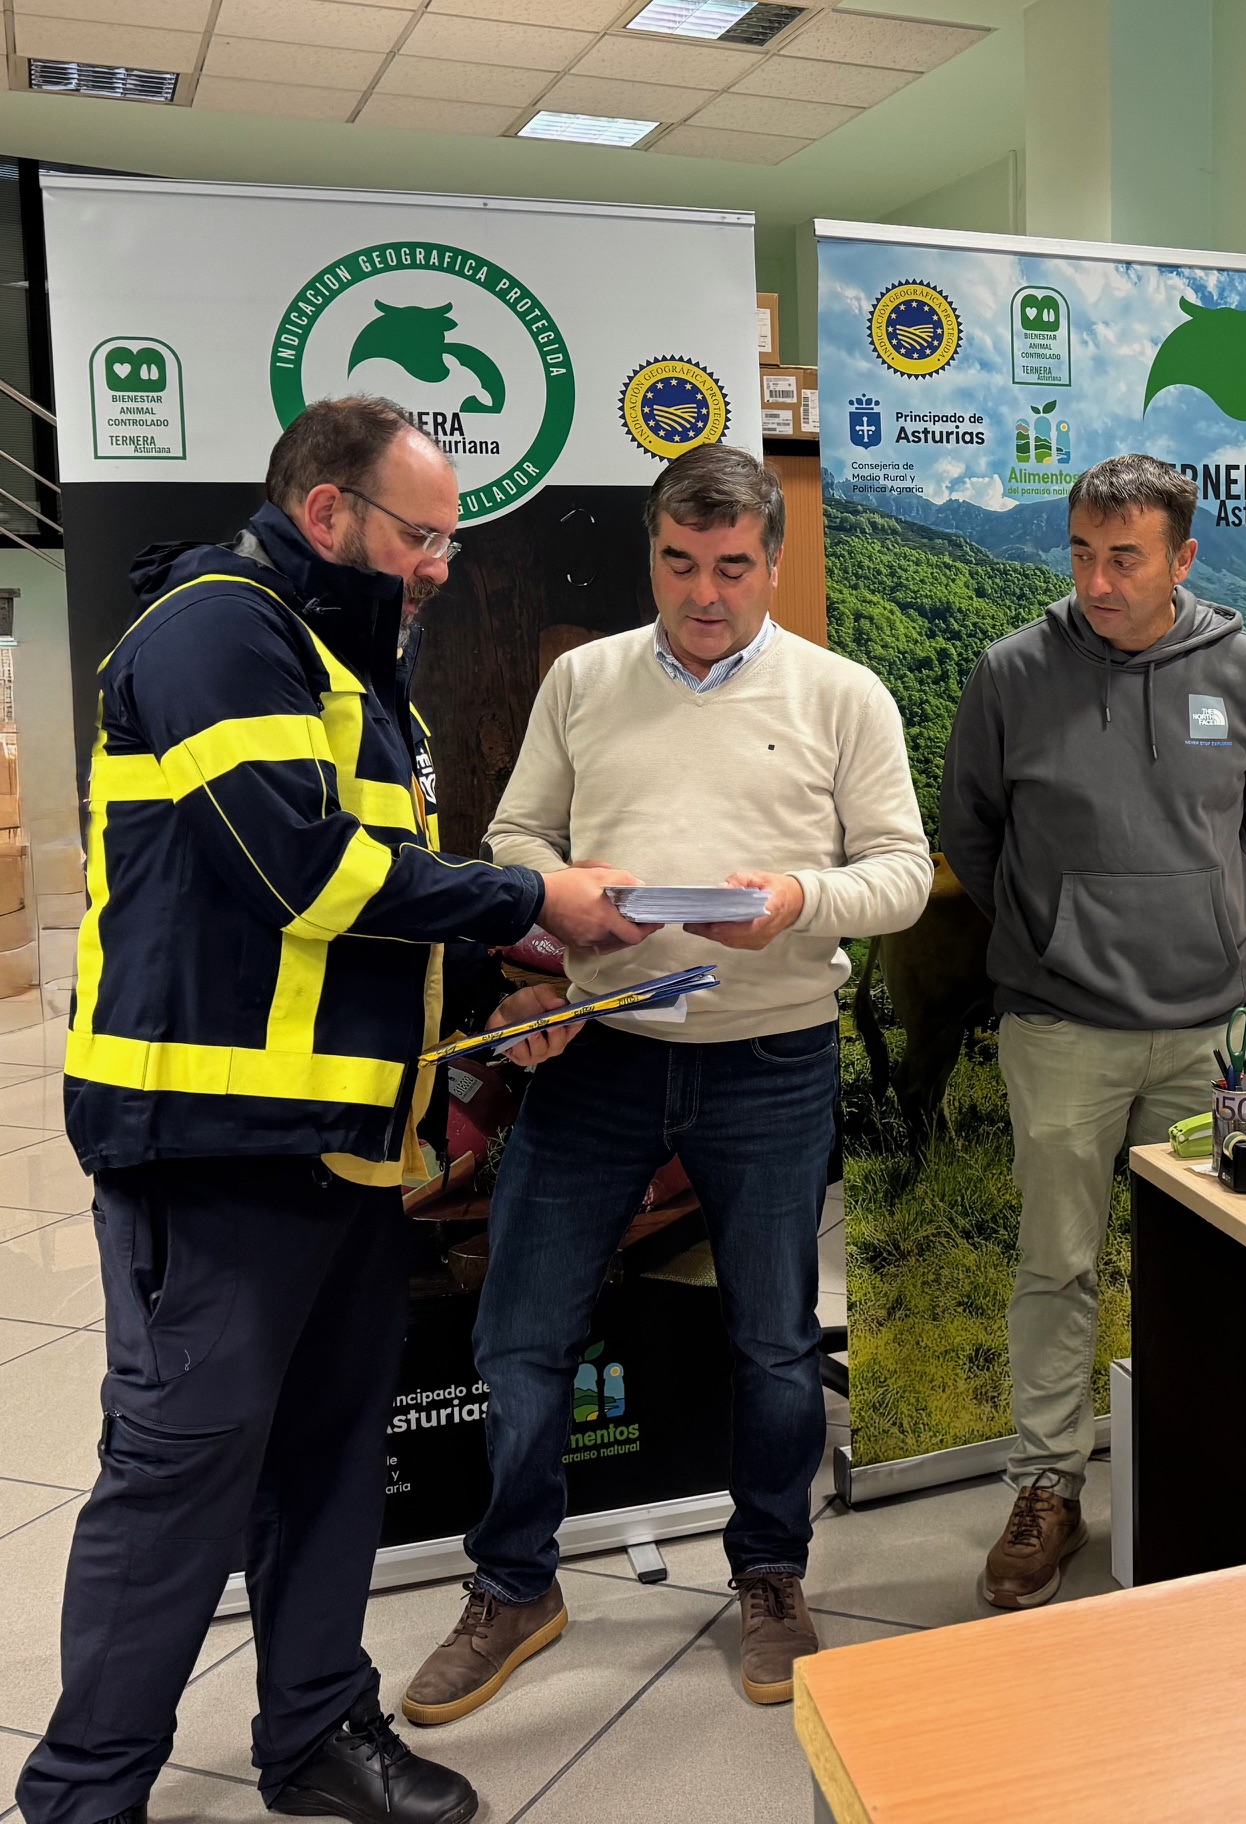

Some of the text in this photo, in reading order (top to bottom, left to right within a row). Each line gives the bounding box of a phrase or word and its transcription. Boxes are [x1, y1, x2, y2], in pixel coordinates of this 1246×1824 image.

[276, 247, 568, 377] INDICACION GEOGRAFICA PROTEGIDA
[938, 308, 955, 358] PROTEGIDA
[1024, 332, 1057, 341] BIENESTAR
[1028, 342, 1053, 350] ANIMAL
[1021, 352, 1061, 360] CONTROLADO
[1022, 365, 1052, 375] TERNERA
[111, 394, 163, 404] BIENESTAR
[643, 364, 707, 387] GEOGRÁFICA
[703, 386, 722, 441] PROTEGIDA
[119, 406, 156, 415] ANIMAL
[107, 418, 169, 427] CONTROLADO
[895, 411, 984, 426] Principado de
[108, 435, 156, 446] TERNERA
[895, 425, 986, 446] Asturias
[133, 445, 171, 454] Asturiana
[902, 461, 915, 471] de
[852, 472, 916, 484] Medio Rural y
[889, 485, 924, 495] Agraria
[600, 1440, 640, 1458] natural
